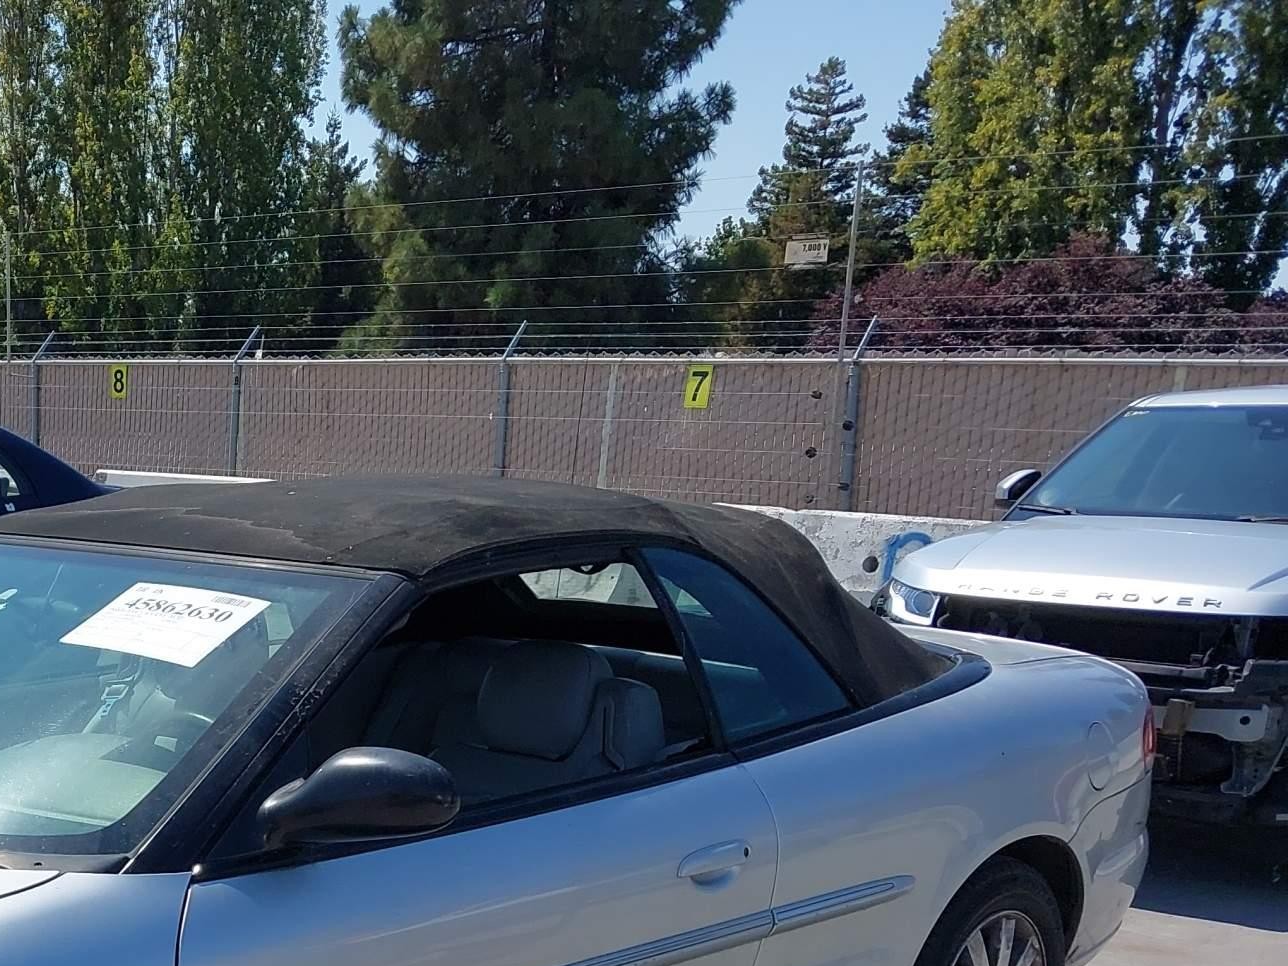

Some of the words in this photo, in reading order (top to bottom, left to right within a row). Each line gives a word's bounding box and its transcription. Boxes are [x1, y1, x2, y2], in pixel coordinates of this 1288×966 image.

[113, 369, 124, 393] 8
[691, 370, 710, 402] 7
[125, 598, 233, 622] 45862630
[1096, 592, 1222, 608] ROVER
